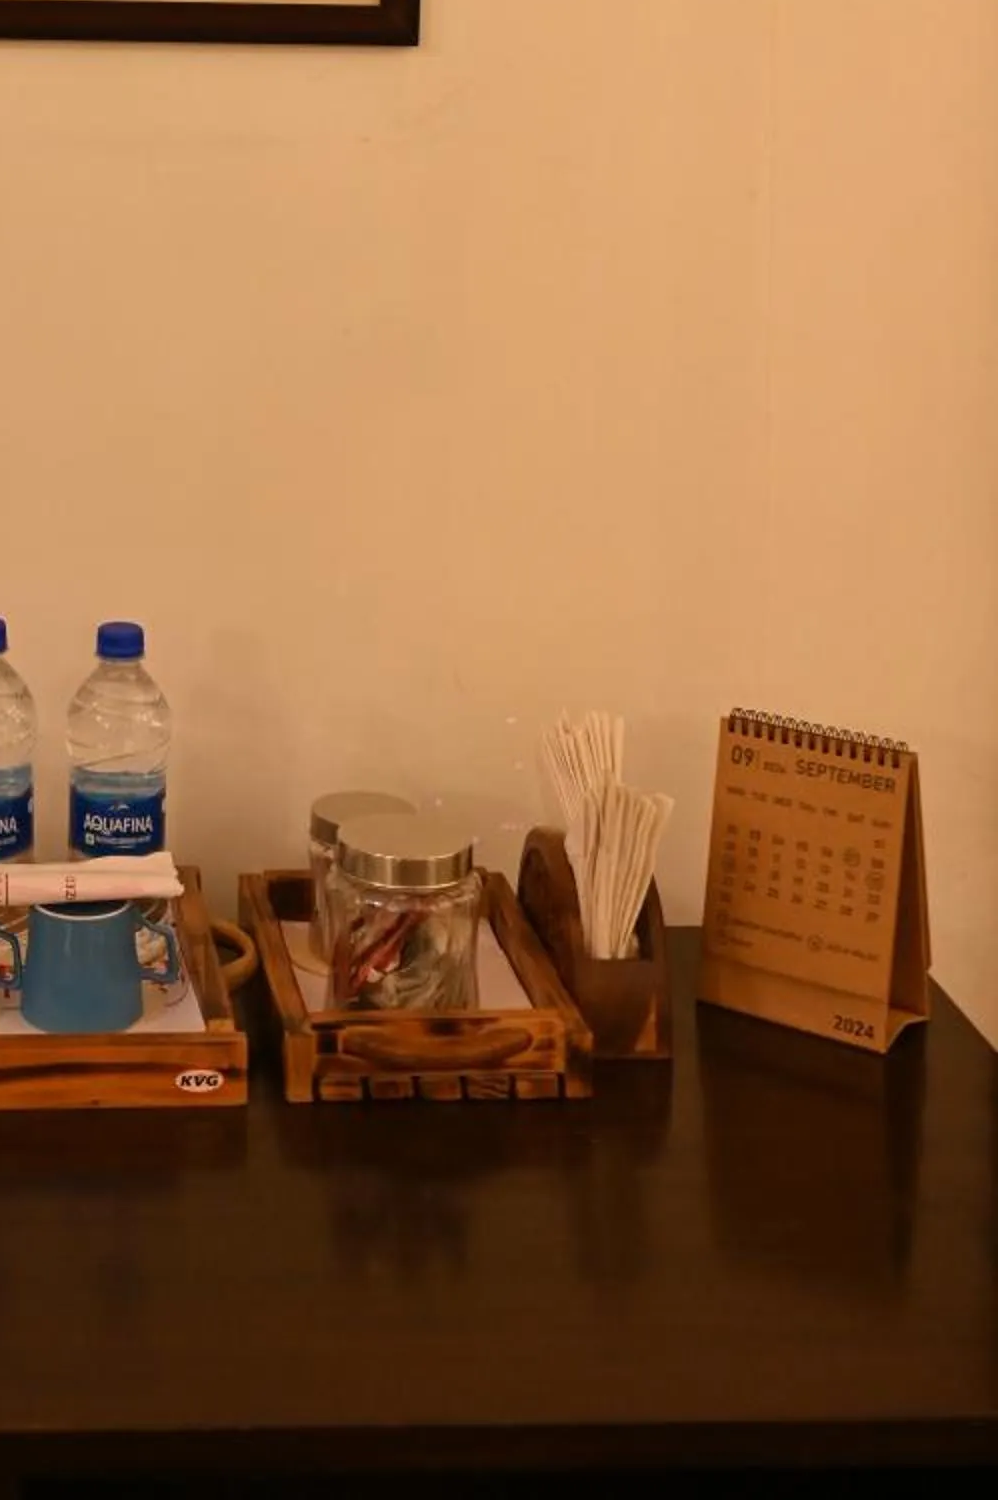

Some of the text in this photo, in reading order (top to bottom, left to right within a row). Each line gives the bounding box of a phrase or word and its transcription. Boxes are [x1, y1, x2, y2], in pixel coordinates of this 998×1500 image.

[731, 744, 754, 766] 09
[795, 758, 896, 793] SEPTEMBER
[84, 813, 154, 836] AQUAFINA
[832, 1014, 875, 1039] 2024
[180, 1074, 219, 1087] KVG
